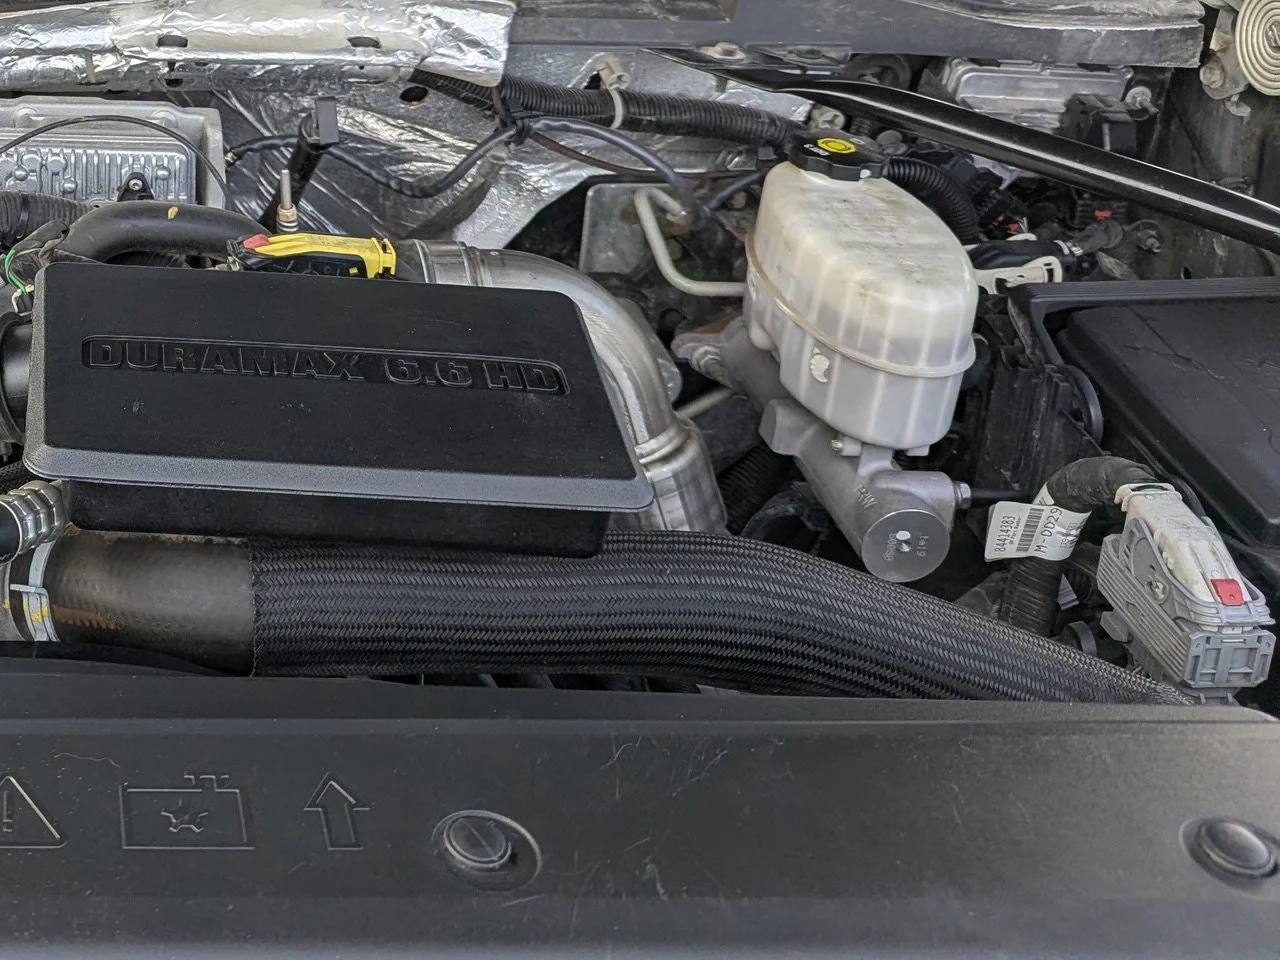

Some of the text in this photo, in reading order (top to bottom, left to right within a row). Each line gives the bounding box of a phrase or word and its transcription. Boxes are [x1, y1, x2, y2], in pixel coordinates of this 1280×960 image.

[88, 340, 561, 391] DURAMAX 6.6 HD
